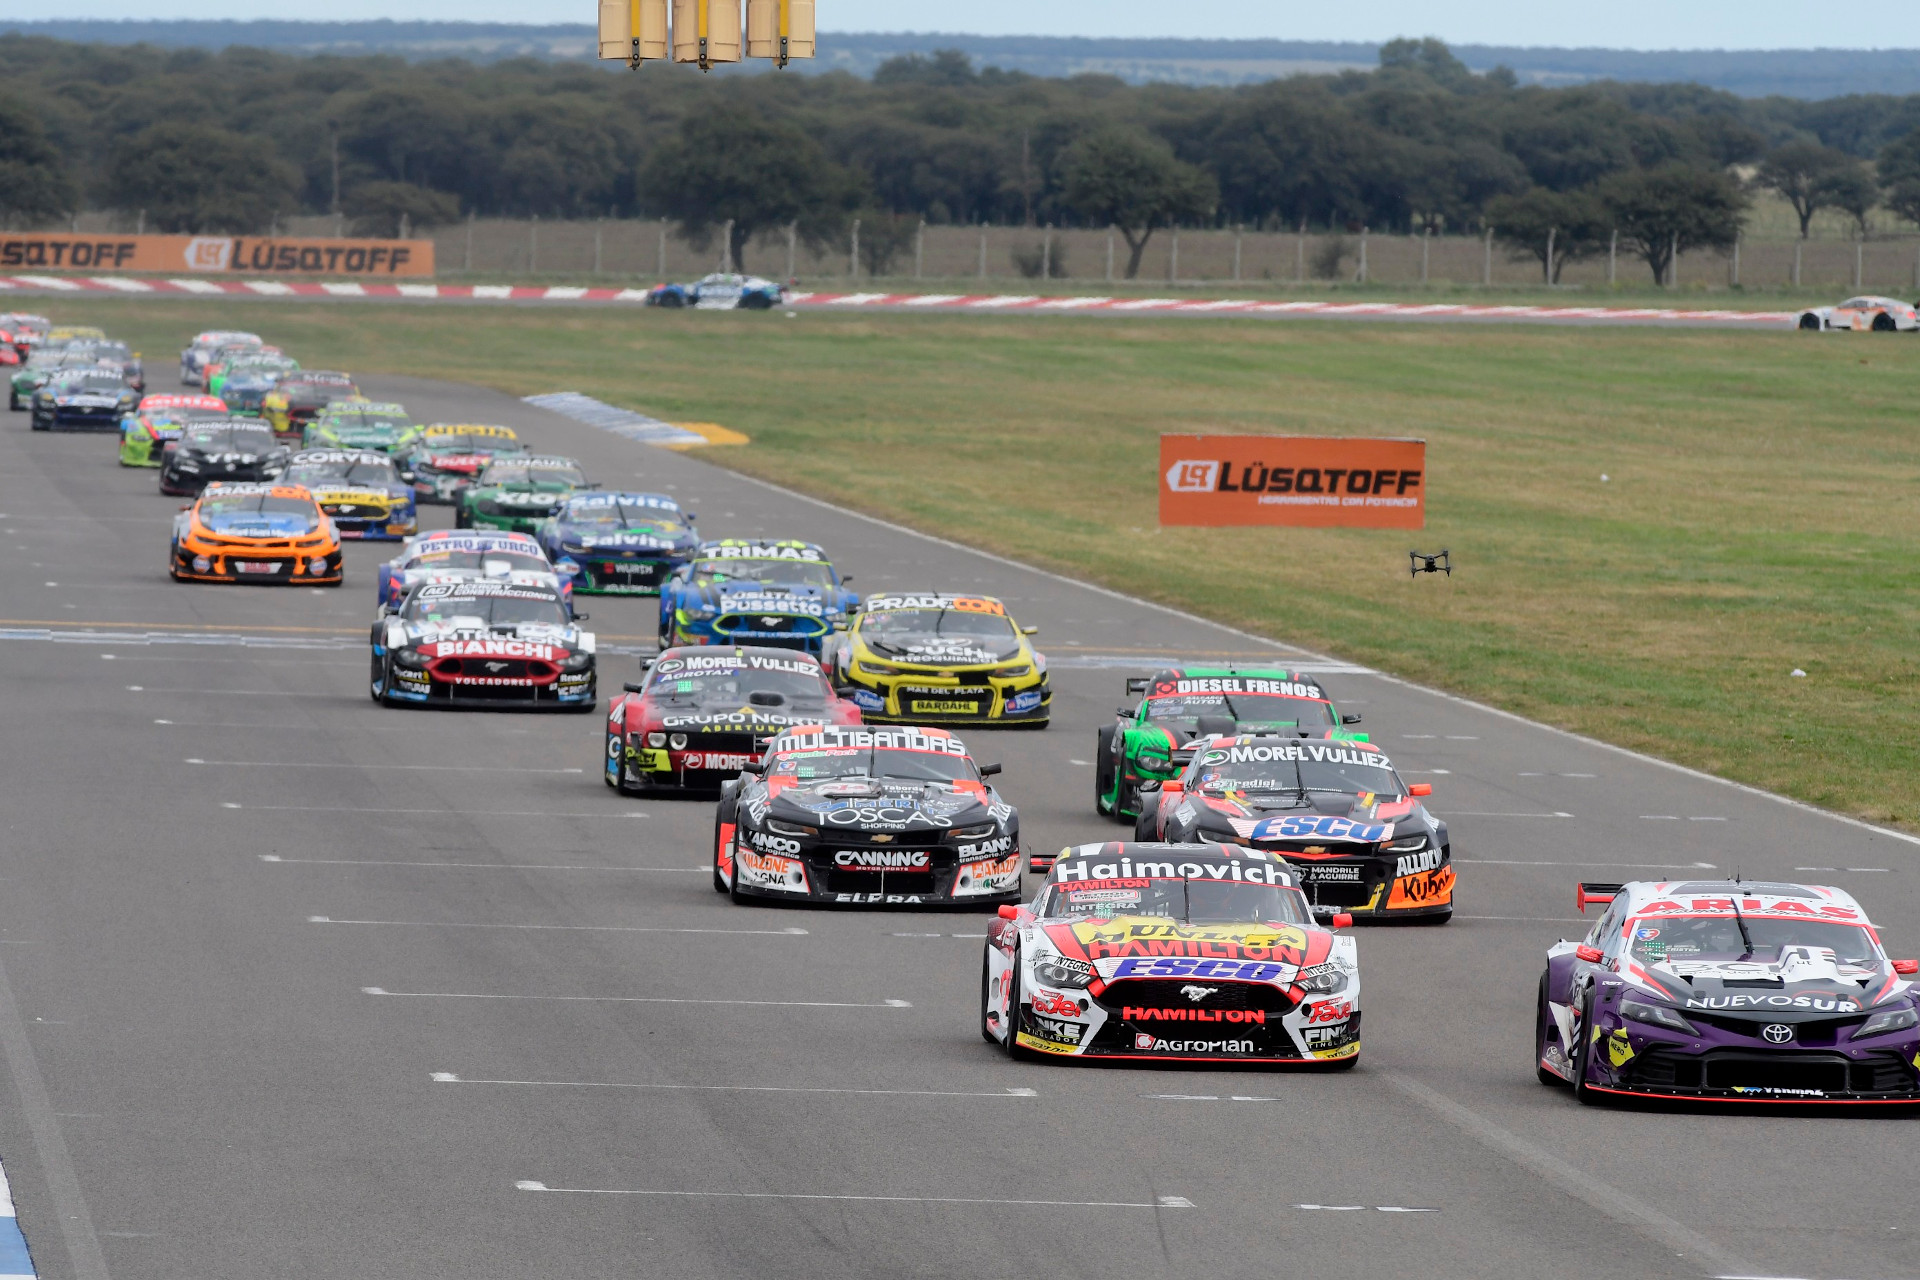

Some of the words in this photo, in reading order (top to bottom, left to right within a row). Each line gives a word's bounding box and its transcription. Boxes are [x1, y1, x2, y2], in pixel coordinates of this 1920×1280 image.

[292, 452, 391, 466] CORVEN
[494, 457, 574, 467] RENAULT
[1217, 461, 1421, 495] LÜSQTOFF
[569, 495, 679, 511] Salvita
[1342, 497, 1364, 507] CON
[421, 539, 473, 553] PETRO
[581, 533, 675, 549] Salvita
[702, 546, 821, 561] TRIMAS
[720, 600, 822, 616] Pussetto
[436, 640, 553, 660] BIANCHI
[687, 656, 748, 669] MOREL
[750, 657, 820, 677] VULLIEZ
[455, 677, 533, 686] VOLCADORES
[1177, 679, 1243, 694] DIESEL
[1246, 680, 1321, 699] FRENOS
[954, 687, 985, 695] PLATA
[663, 713, 746, 727] GRUPO
[777, 731, 967, 755] MULTIBANDAS
[1231, 746, 1309, 763] MOREL
[1308, 746, 1394, 771] VULLIEZ
[817, 808, 953, 827] TOSCAS
[1251, 816, 1386, 842] ESCO
[835, 851, 930, 866] CANNING
[1057, 857, 1292, 887] Haimovich
[1311, 866, 1360, 874] MANDRILE
[1318, 873, 1360, 881] AGUIRRE
[1059, 880, 1150, 893] HAMILTON
[1070, 902, 1138, 912] INTEGRA
[1637, 899, 1859, 919] ARIAS
[1089, 940, 1301, 966] HAMILTON
[1053, 956, 1092, 973] INTEGRA
[1113, 958, 1283, 980] ESCO
[1303, 962, 1336, 978] INTEGRA
[1686, 995, 1858, 1012] NUEVOSUR
[1122, 1006, 1266, 1024] HAMILTON
